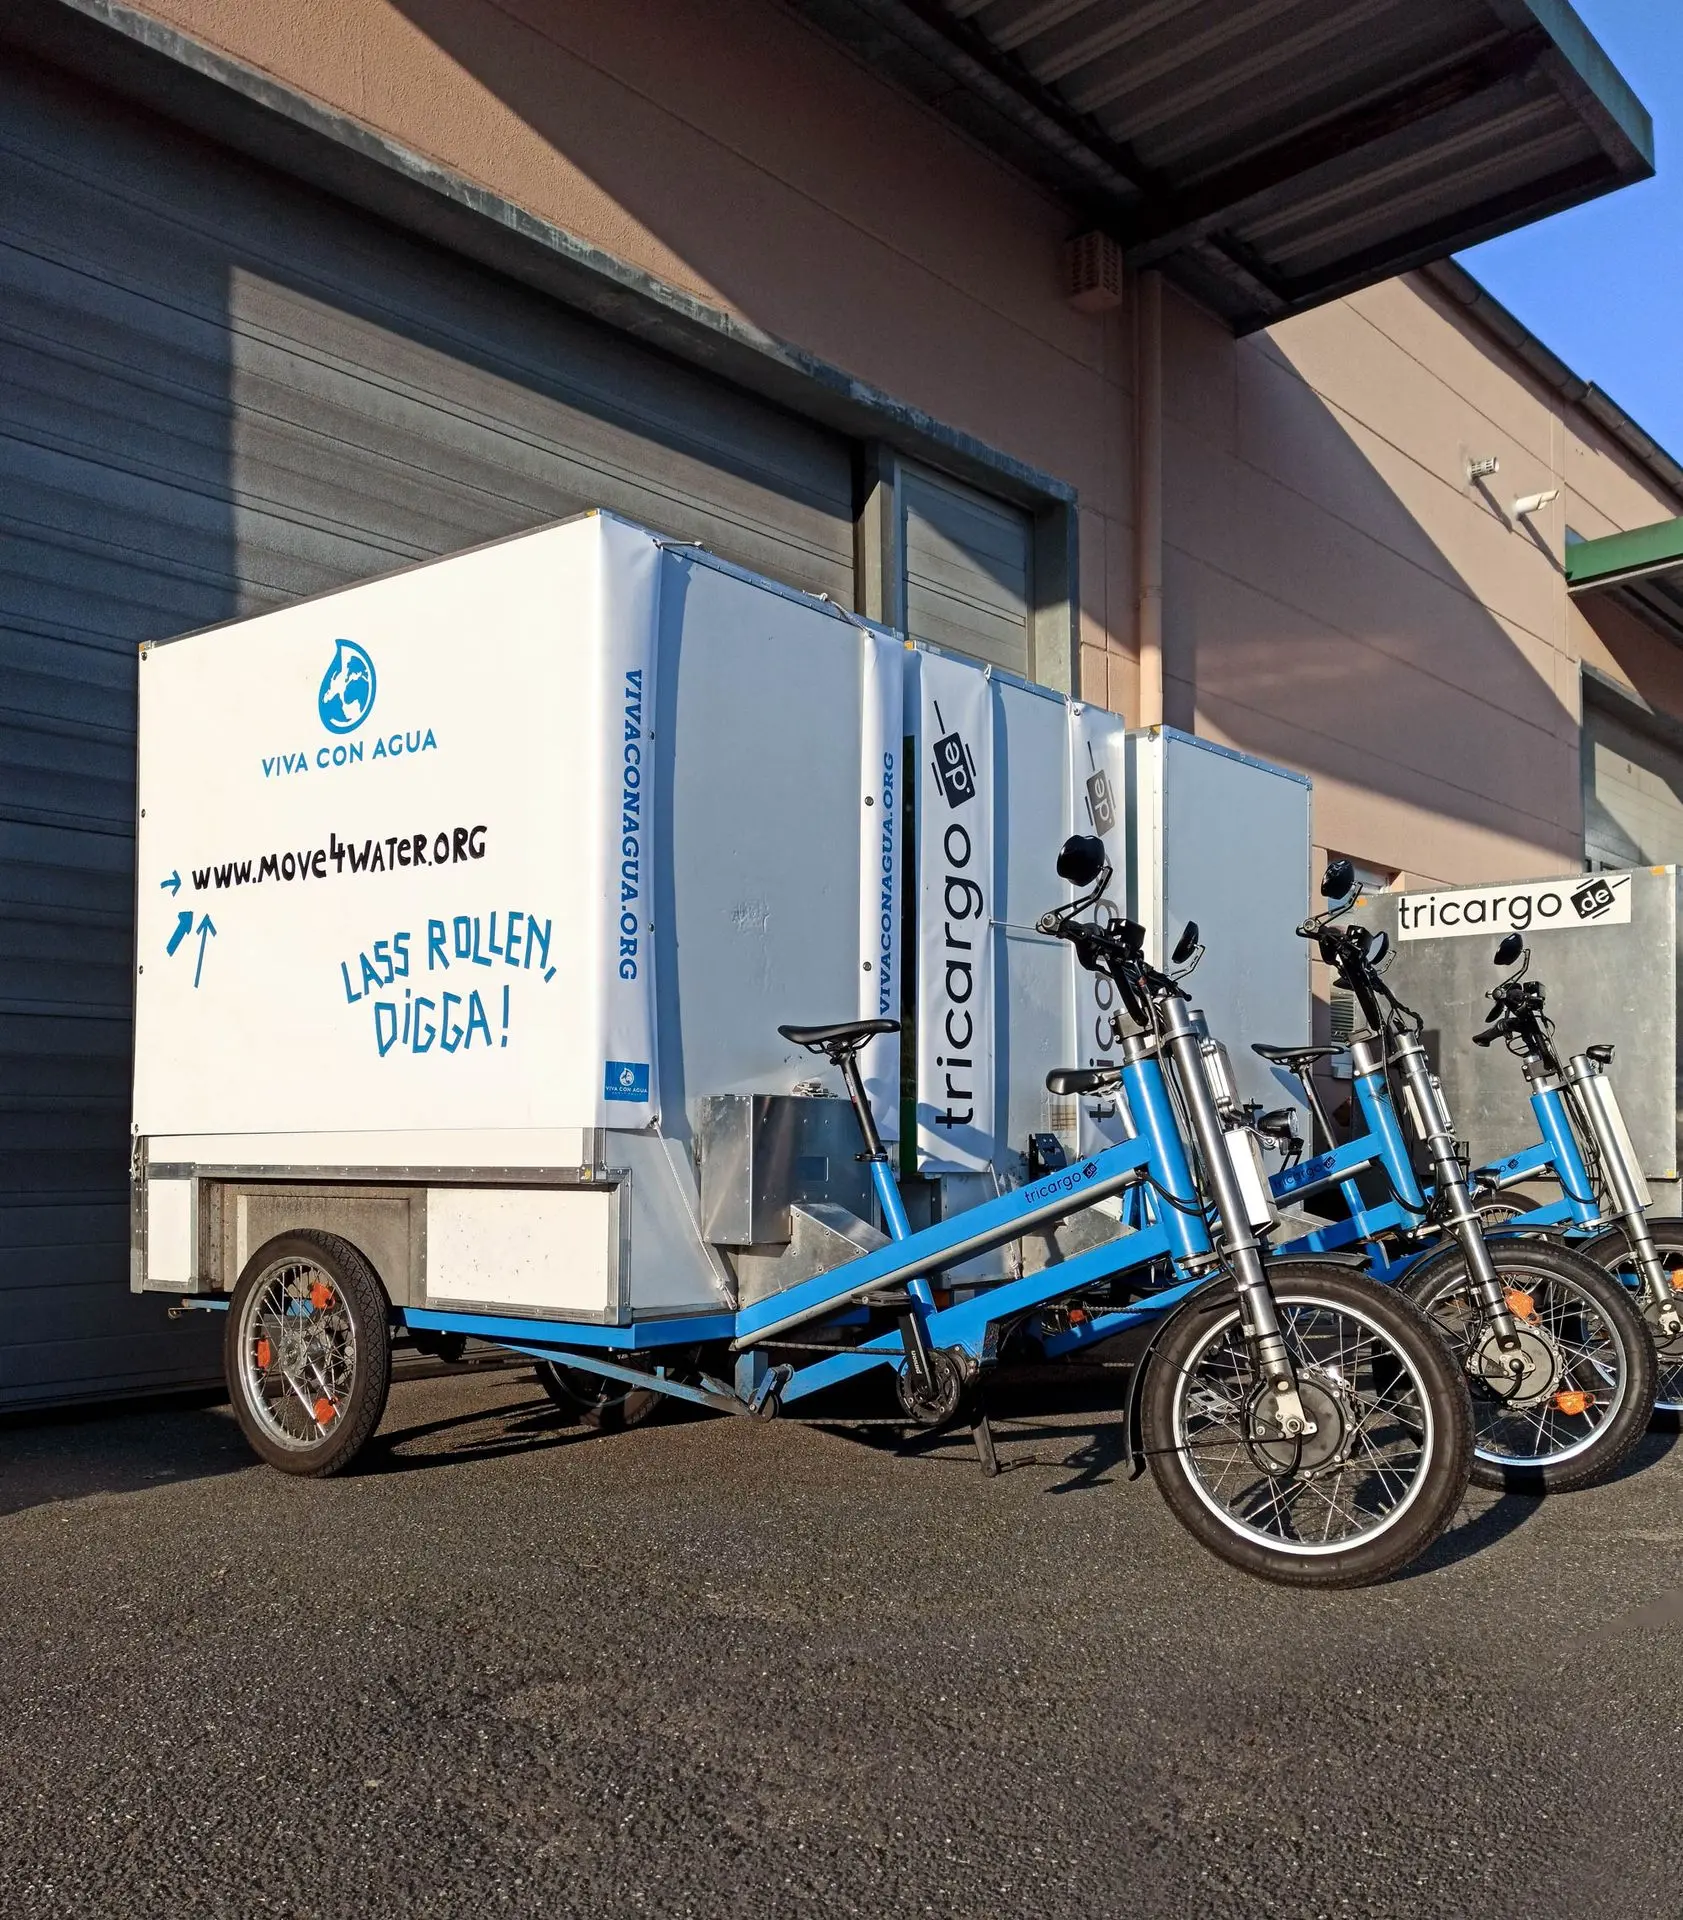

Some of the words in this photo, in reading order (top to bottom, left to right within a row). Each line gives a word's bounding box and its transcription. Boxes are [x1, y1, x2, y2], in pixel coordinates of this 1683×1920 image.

[261, 752, 309, 778] VIVA
[316, 741, 364, 769] CON
[372, 728, 437, 760] AGUA
[943, 738, 973, 796] .de
[619, 669, 642, 980] VIVACONAGUA.ORG
[880, 751, 894, 1016] VIVACONAGUA.ORG
[1398, 893, 1562, 930] tricargo
[1578, 886, 1612, 916] .de
[341, 932, 411, 1004] LASS
[428, 911, 557, 983] ROLLEN,
[935, 823, 984, 1130] tricargo
[1024, 1172, 1082, 1203] tricargo
